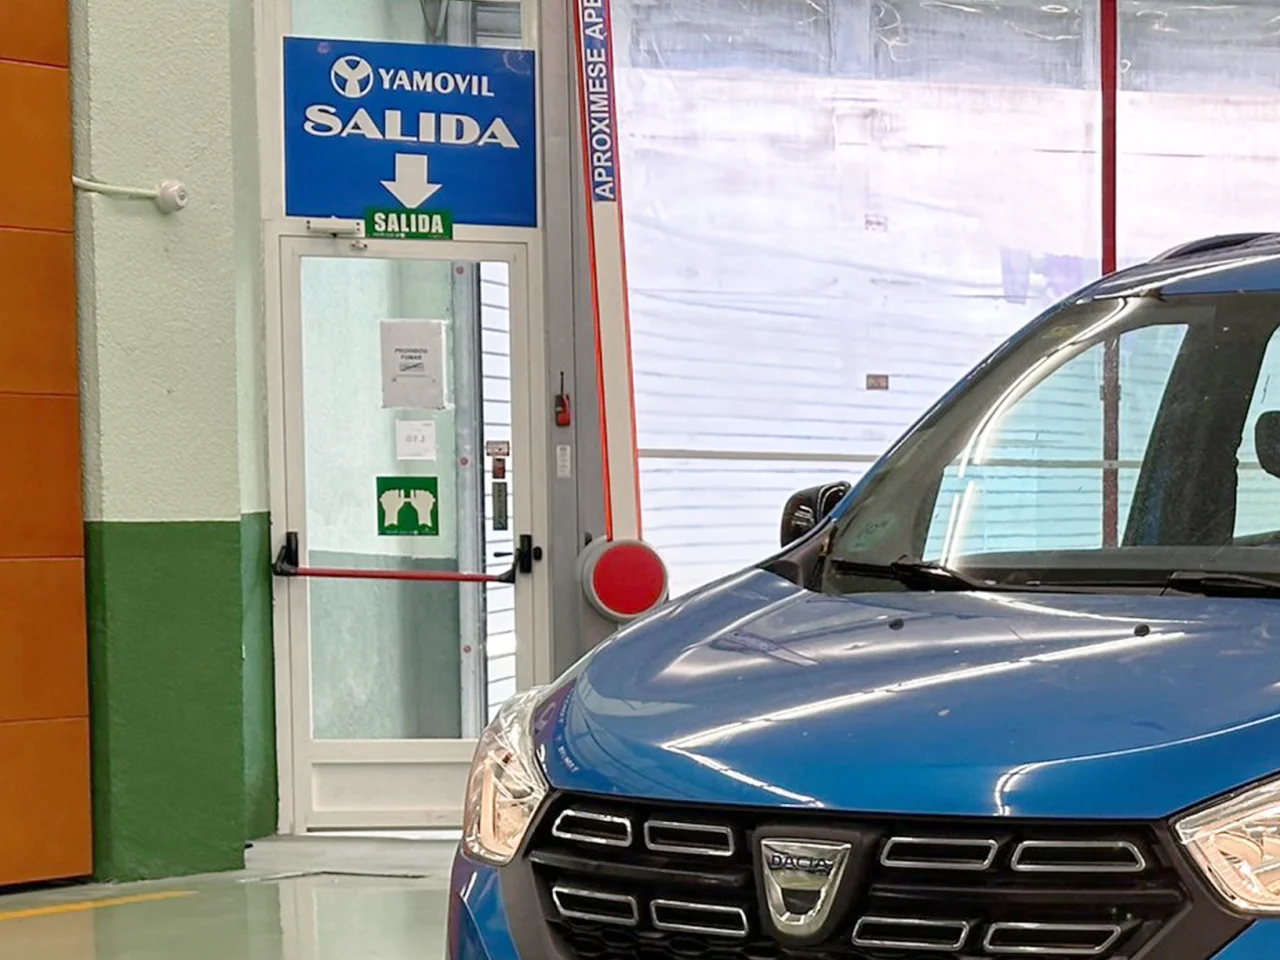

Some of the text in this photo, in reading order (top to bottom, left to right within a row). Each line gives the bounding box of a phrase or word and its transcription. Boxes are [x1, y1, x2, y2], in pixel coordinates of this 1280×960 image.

[378, 68, 494, 97] YAMOVIL
[304, 105, 519, 149] SALIDA
[585, 48, 615, 200] APROXIMESE
[374, 212, 444, 234] SALIDA
[769, 854, 834, 875] DACIA
